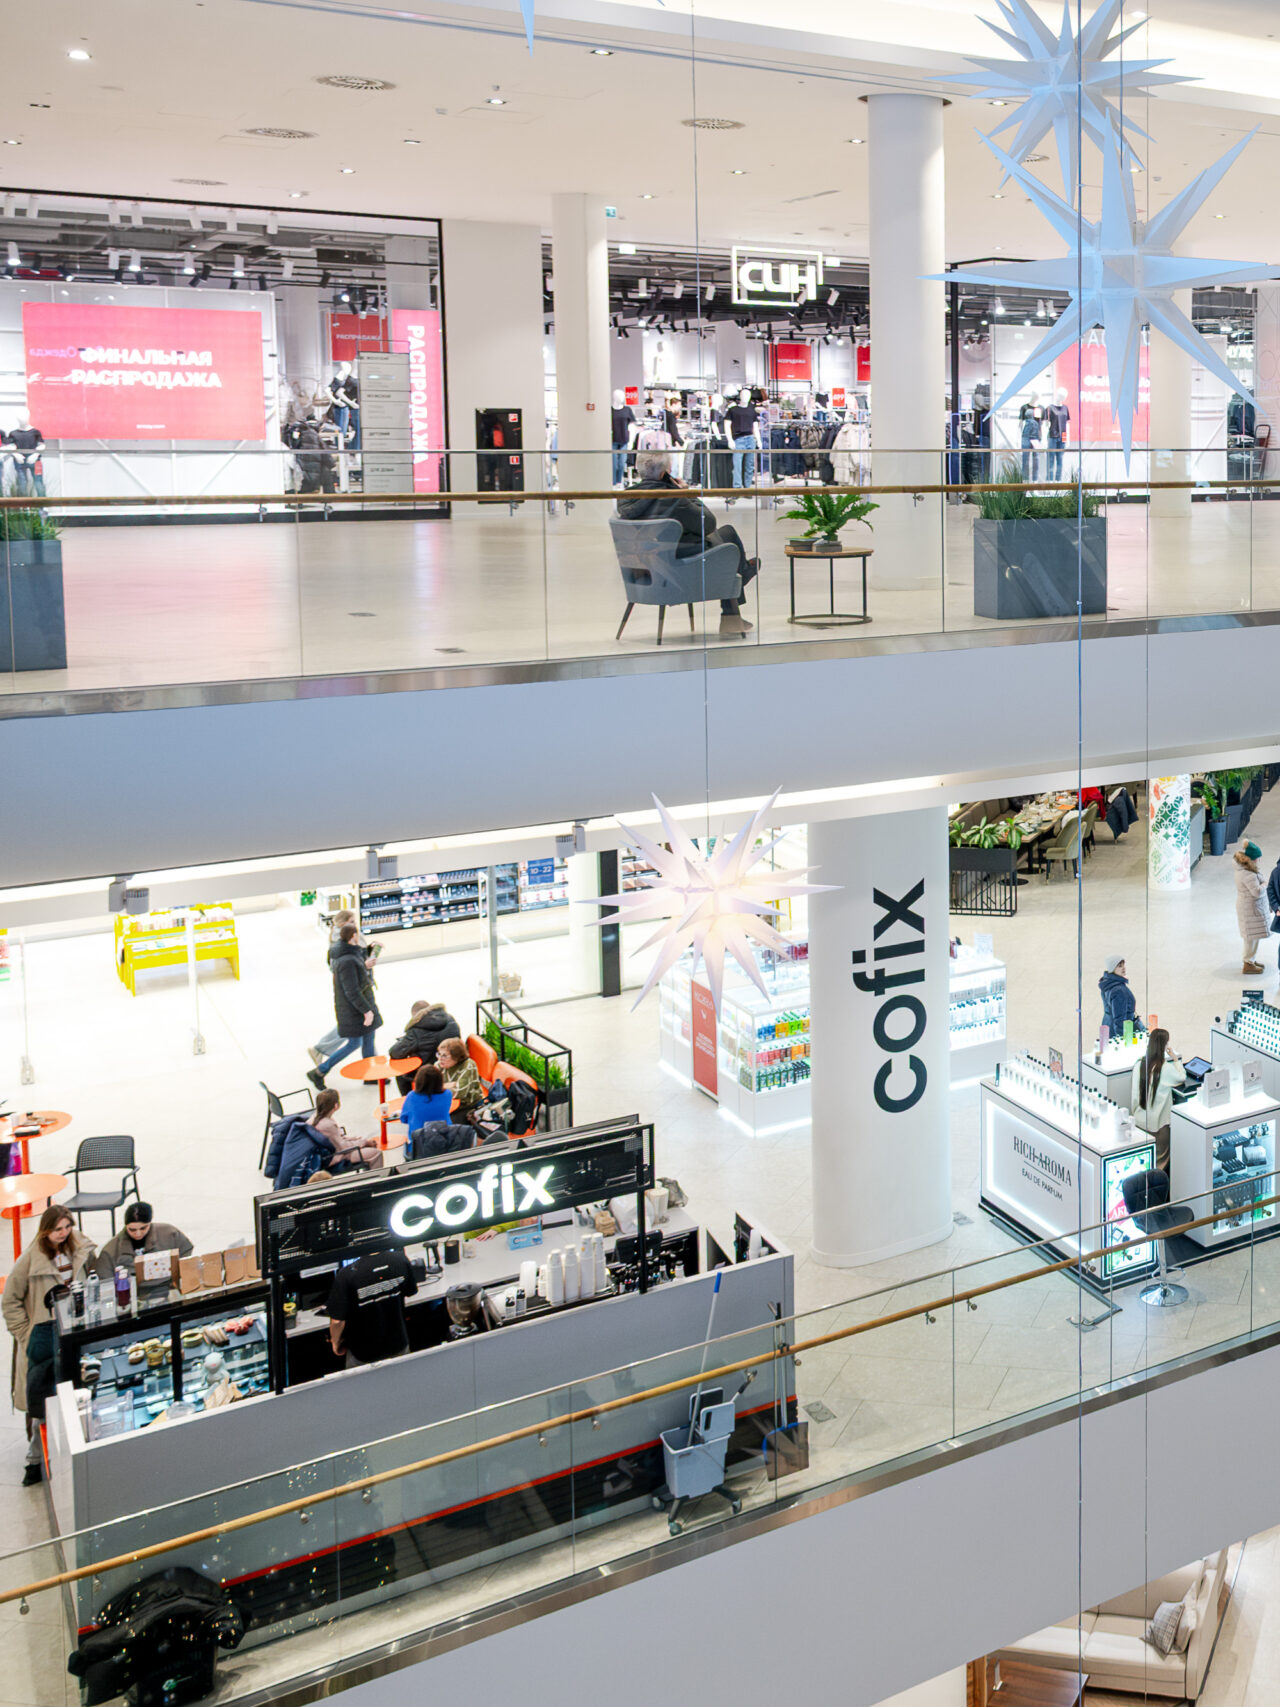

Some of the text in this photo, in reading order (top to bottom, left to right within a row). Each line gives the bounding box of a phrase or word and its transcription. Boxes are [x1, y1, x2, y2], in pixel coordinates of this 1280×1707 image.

[71, 369, 223, 390] РАСПРОДАЖА
[79, 347, 213, 367] ФИНАЛЬНАЯ
[407, 325, 430, 465] РАСПРОДАЖА
[853, 877, 928, 1113] cofix
[389, 1161, 556, 1238] cofix
[1021, 1167, 1064, 1201] EAU DE PARFUM
